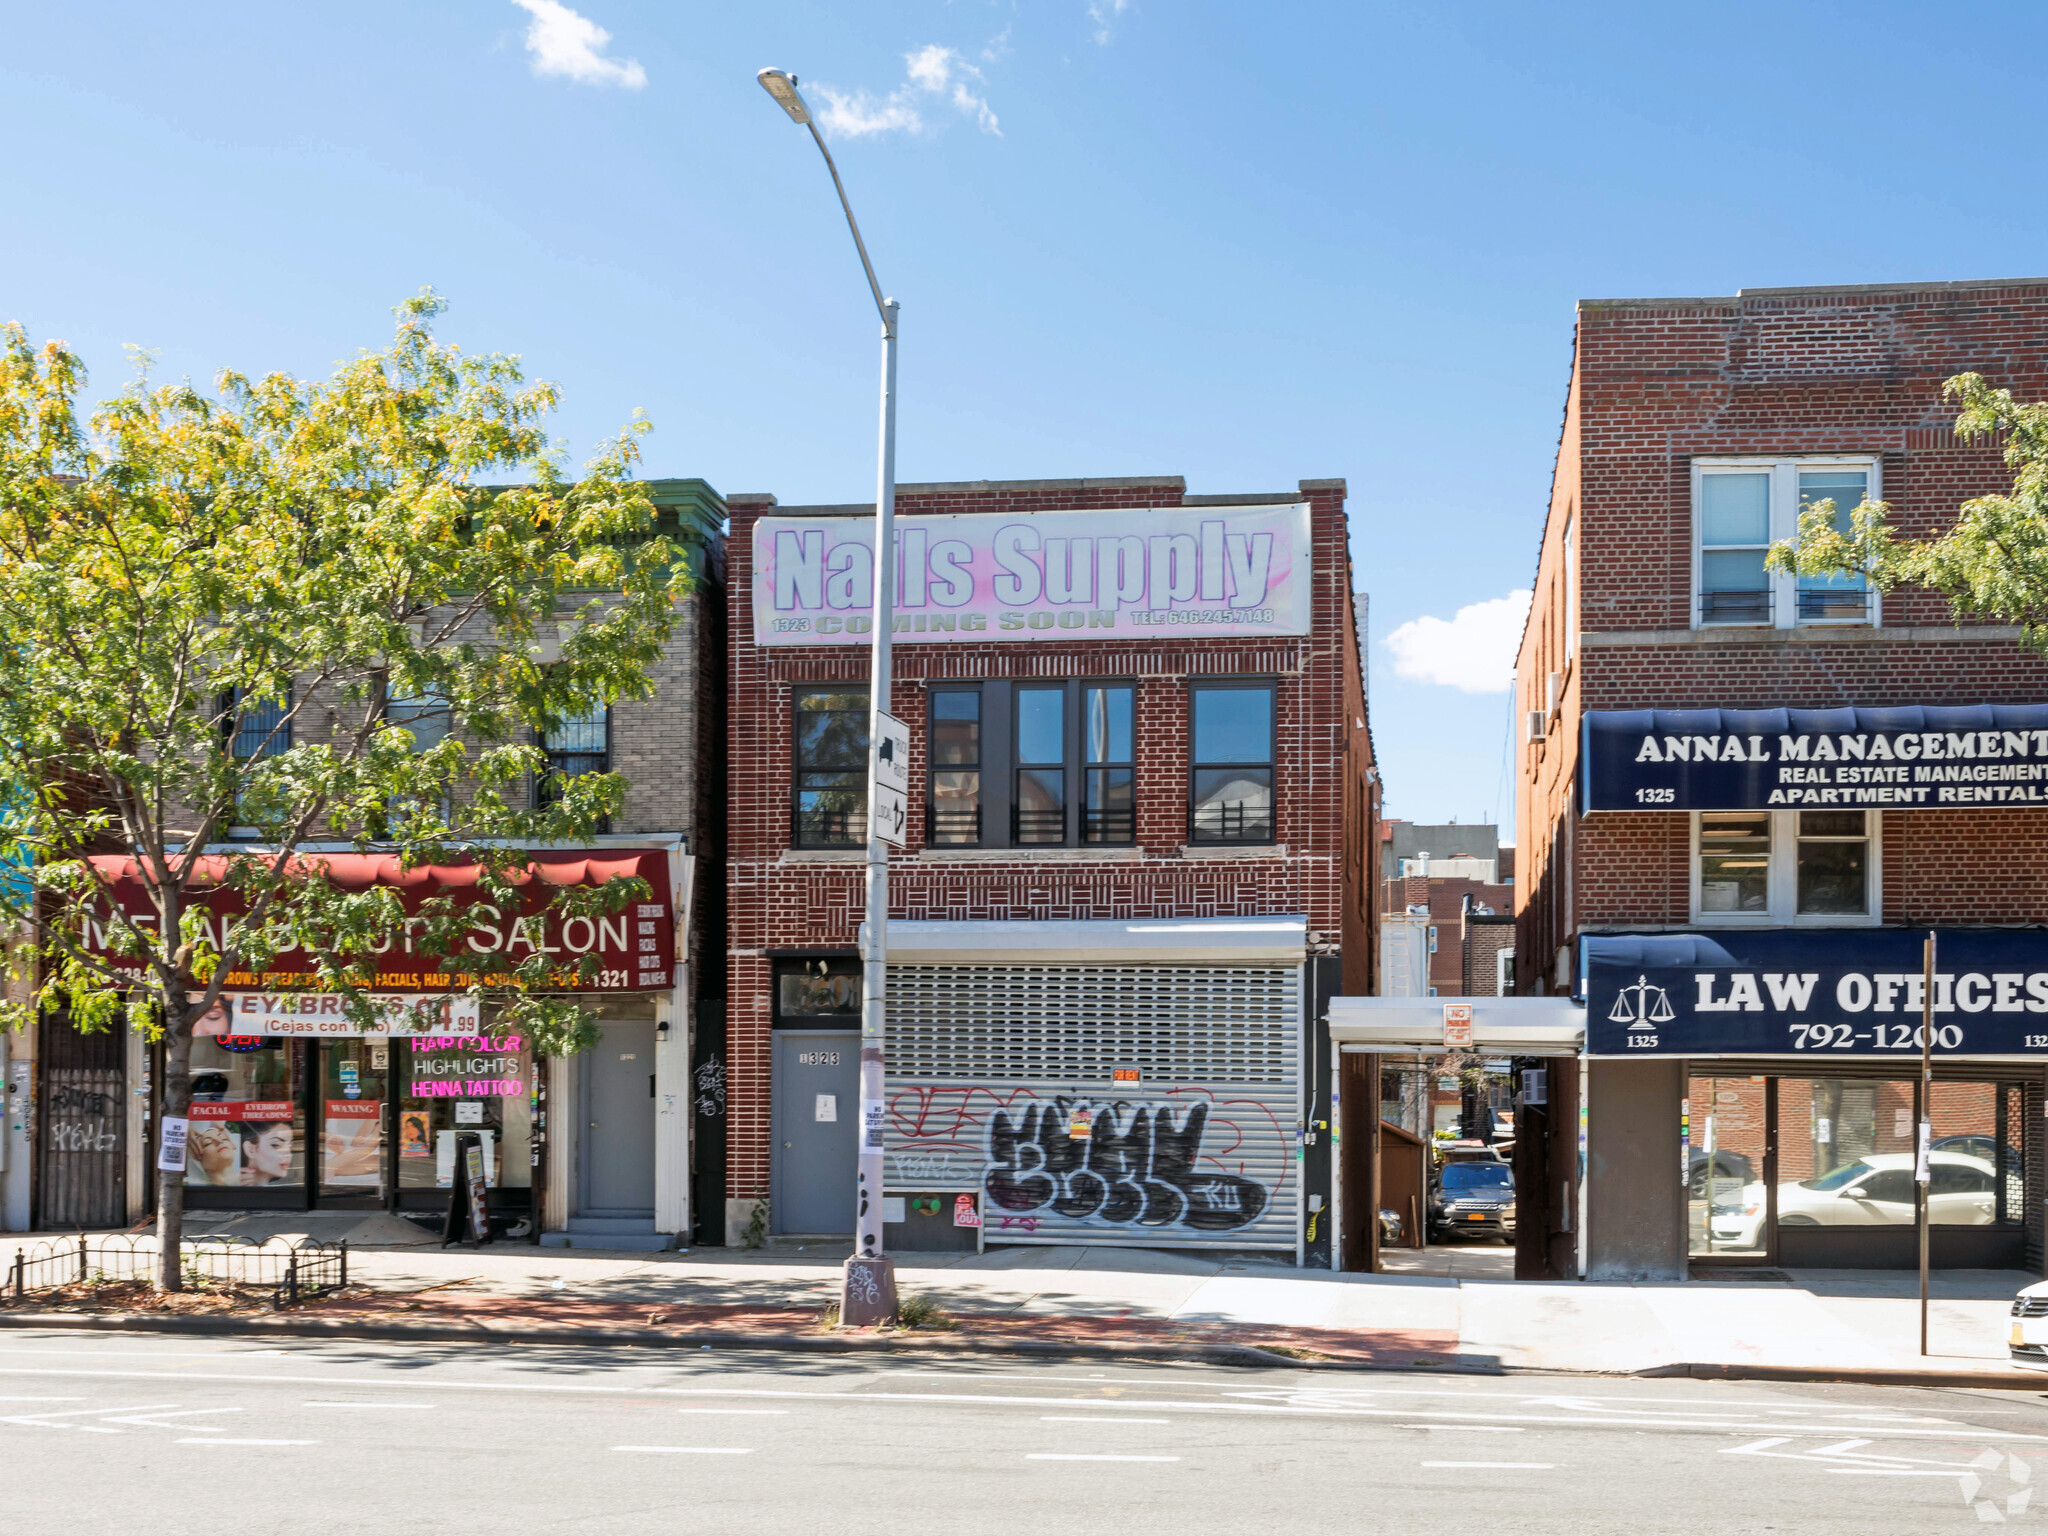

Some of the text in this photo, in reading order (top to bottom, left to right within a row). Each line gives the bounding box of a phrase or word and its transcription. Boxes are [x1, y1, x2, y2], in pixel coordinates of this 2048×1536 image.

[992, 520, 1274, 611] Supply
[771, 618, 811, 633] 1323
[998, 610, 1117, 631] SOON
[1130, 612, 1165, 626] TEL:
[1634, 730, 2048, 763] ANNAL MANAGEMENT
[1778, 767, 1832, 784] REAL
[1835, 766, 1909, 784] ESTATE
[1635, 788, 1675, 803] 1325
[1768, 787, 1926, 804] APARTMENT
[1694, 972, 2048, 1013] LAW OFFICES
[1451, 1009, 1465, 1018] NO
[265, 1020, 314, 1034] (Cejas
[319, 1023, 347, 1032] con
[1627, 1035, 1658, 1048] 1325
[1789, 1023, 1963, 1049] 792-1200
[2024, 1035, 2048, 1048] 132
[412, 1036, 521, 1052] HAIR COLOR
[414, 1058, 519, 1075] HIGHLIGHTS
[412, 1080, 522, 1097] HENNA TATTOO
[193, 1106, 231, 1115] FACIAL
[245, 1103, 287, 1111] EYEBROW
[331, 1104, 374, 1114] WAXING
[241, 1111, 292, 1120] THREADING
[959, 1214, 979, 1224] OUT
